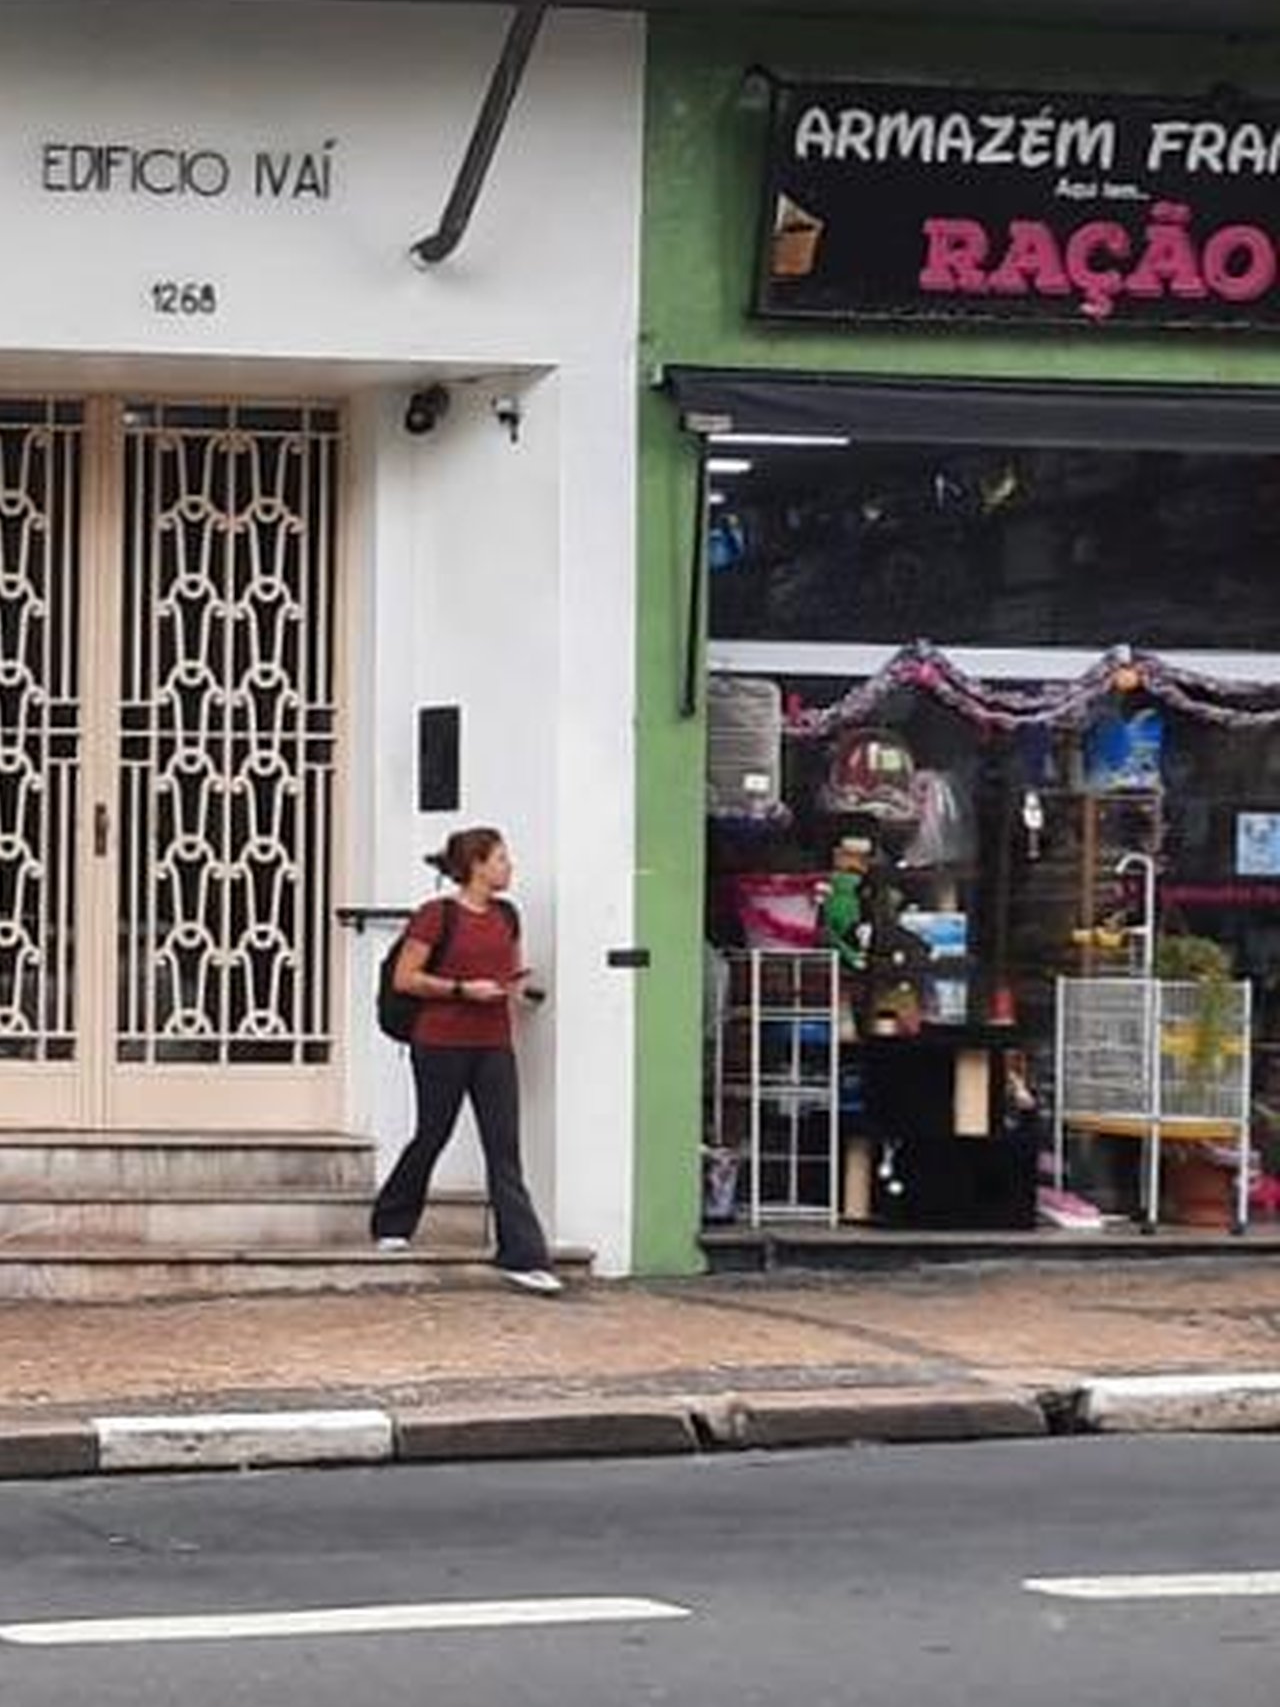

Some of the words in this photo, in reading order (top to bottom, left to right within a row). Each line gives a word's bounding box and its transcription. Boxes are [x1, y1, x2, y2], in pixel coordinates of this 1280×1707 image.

[42, 144, 231, 196] EDIFICIO
[254, 139, 337, 199] IVAÍ
[794, 106, 1116, 171] ARMAZÉM
[919, 200, 1278, 323] RAÇÃO
[151, 282, 217, 314] 1268
